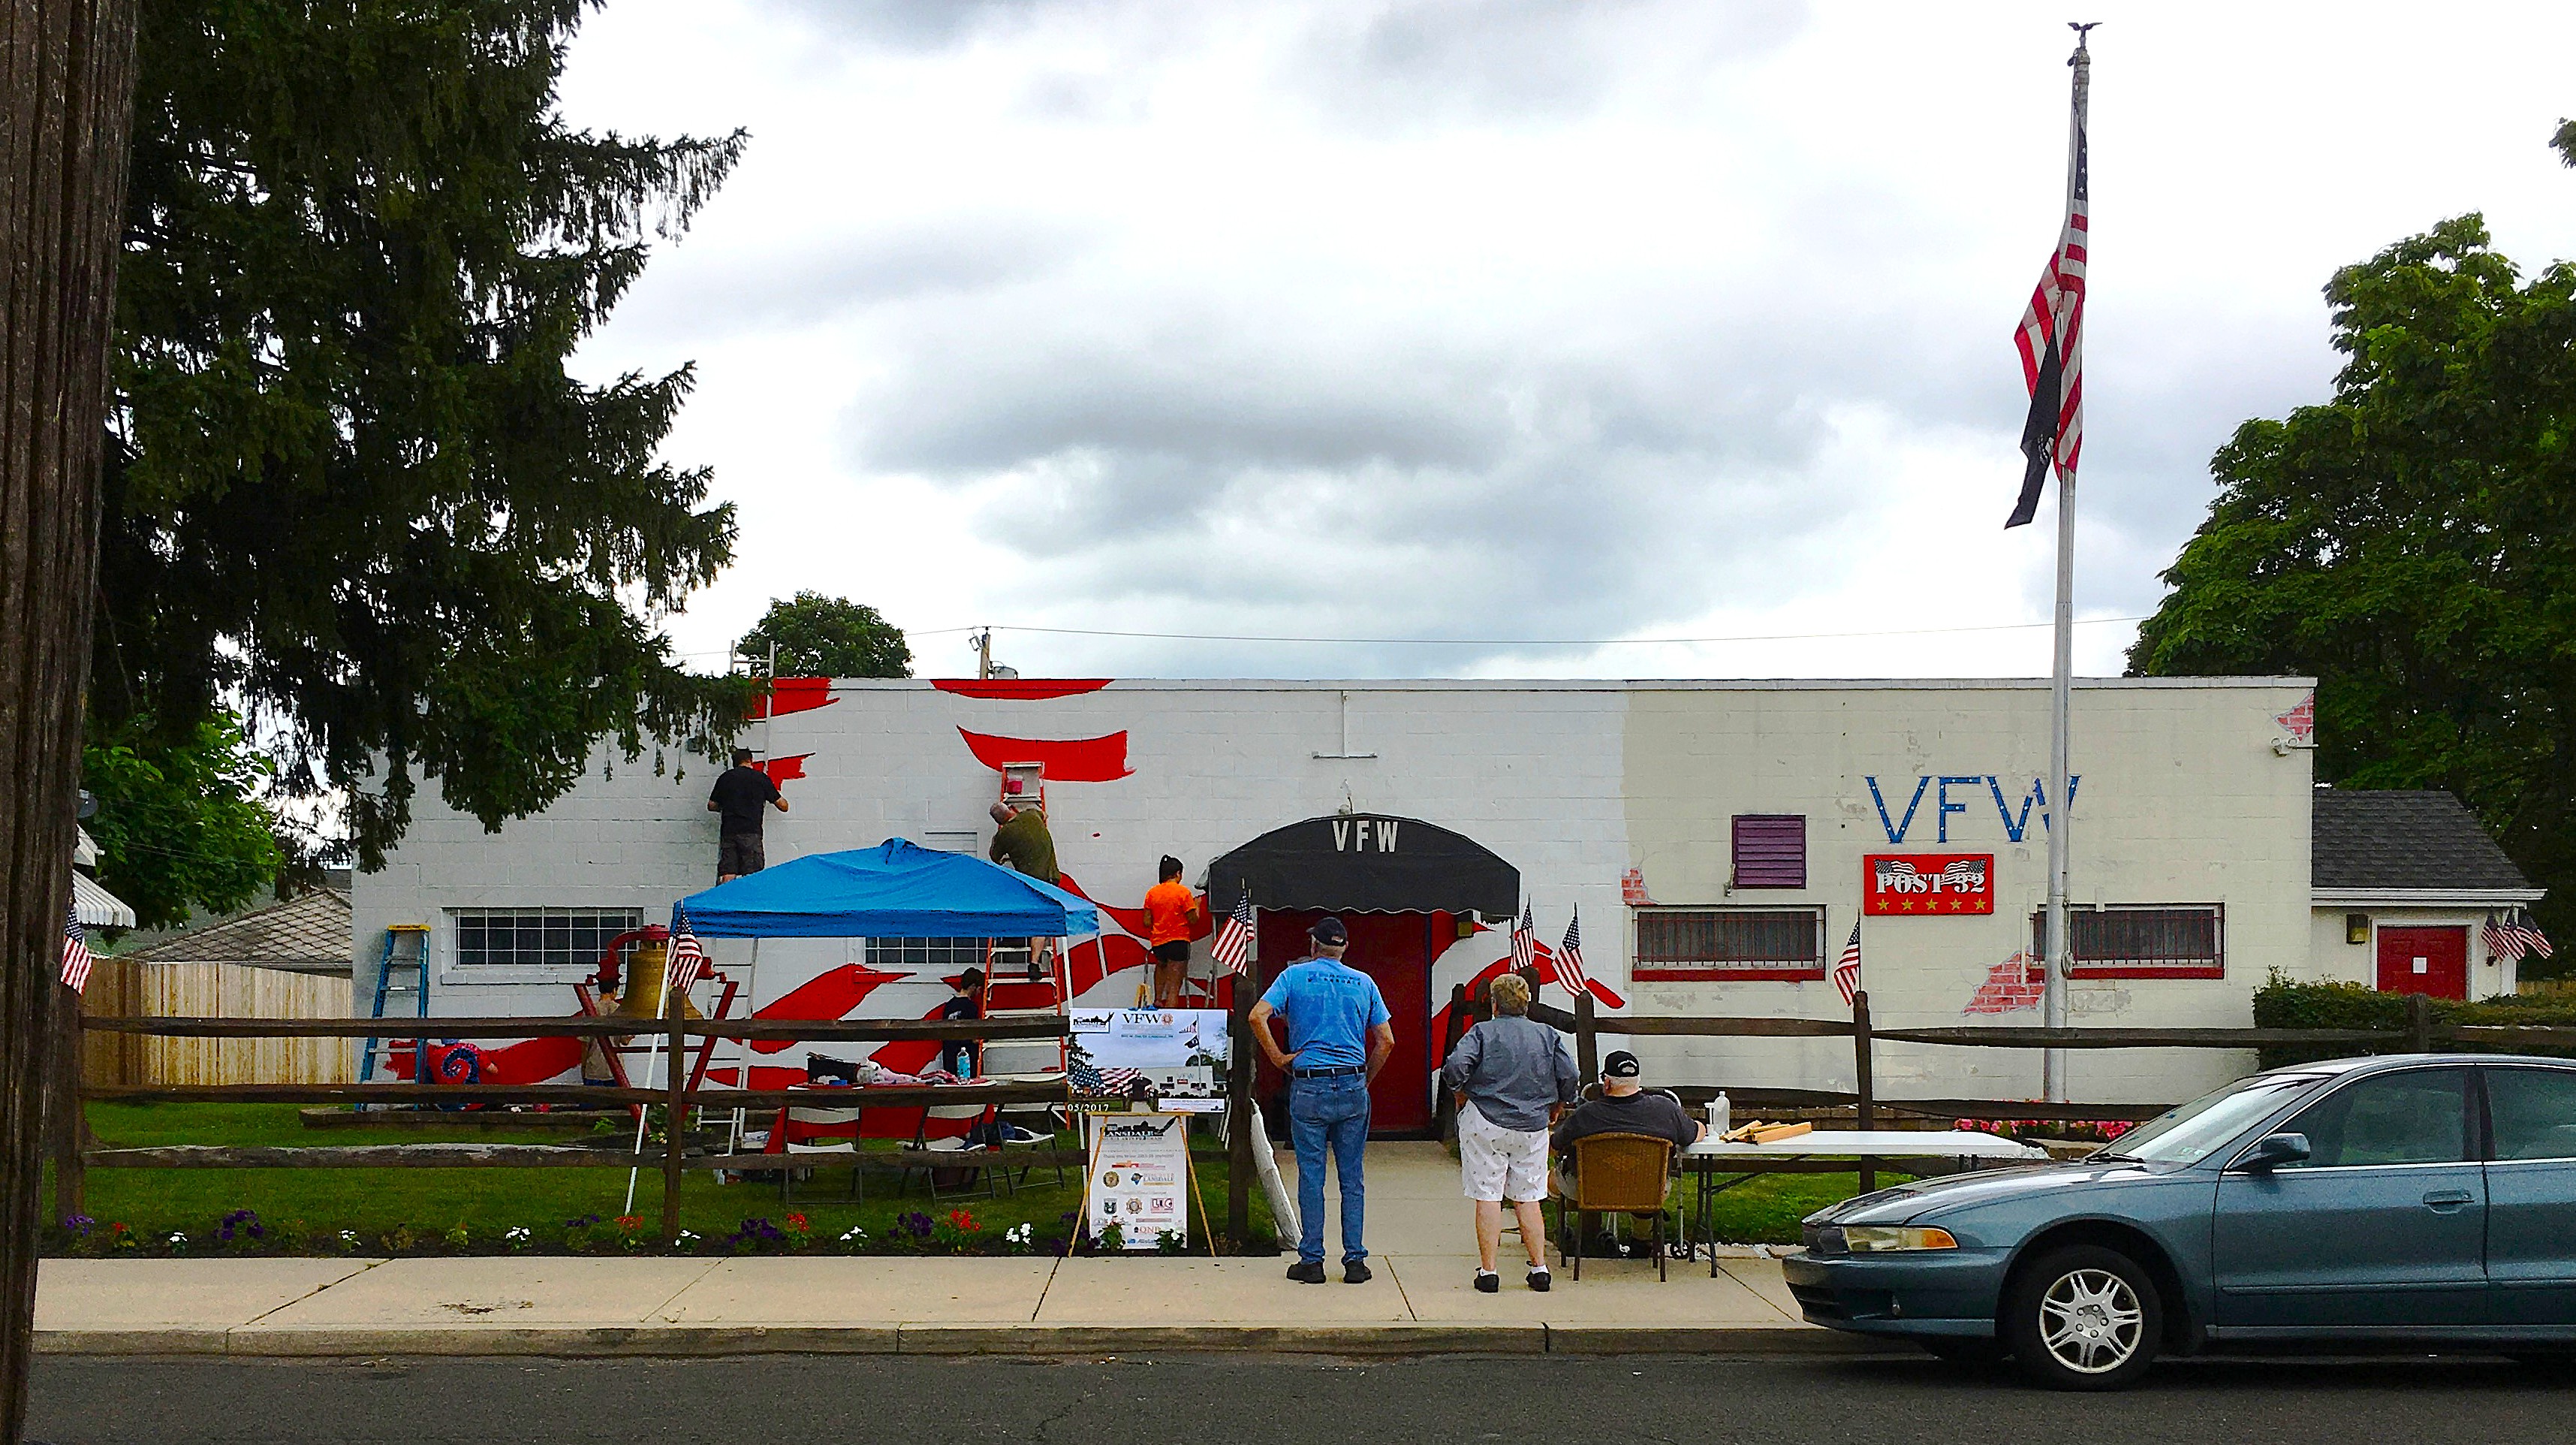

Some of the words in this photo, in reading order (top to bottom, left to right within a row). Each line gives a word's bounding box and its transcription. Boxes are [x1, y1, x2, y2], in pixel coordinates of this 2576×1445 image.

[1864, 776, 2082, 843] VFW
[1333, 821, 1398, 852] VFW
[1876, 873, 1946, 894] POST
[1954, 873, 1985, 894] 32
[1122, 1013, 1161, 1024] VFW
[1067, 1103, 1109, 1112] 05/2017
